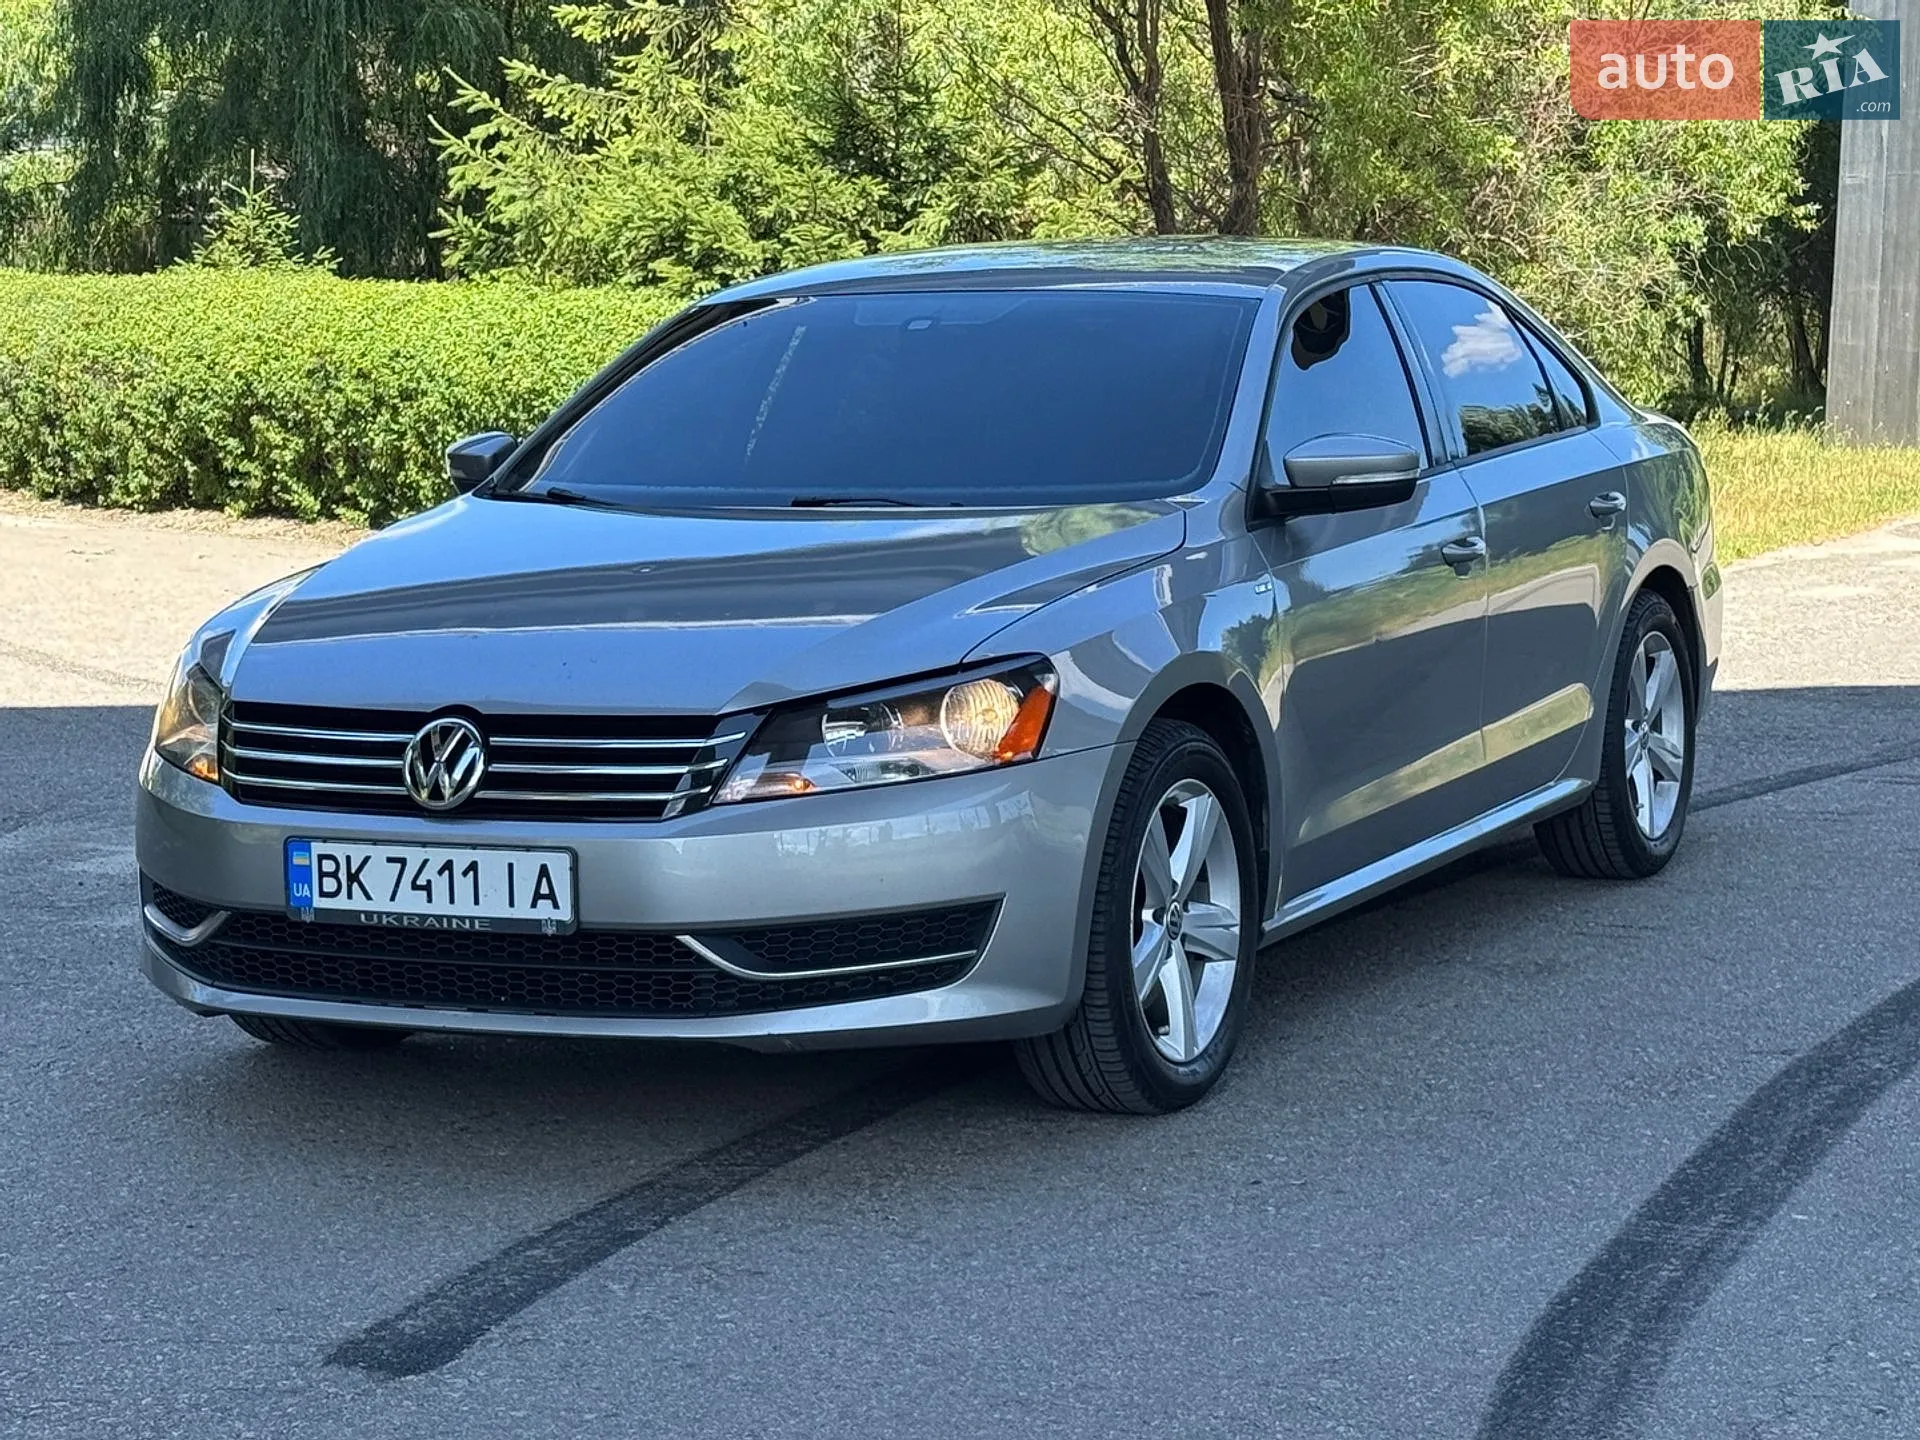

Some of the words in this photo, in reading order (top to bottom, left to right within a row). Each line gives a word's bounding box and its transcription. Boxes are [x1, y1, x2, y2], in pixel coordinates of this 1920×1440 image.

[317, 854, 373, 901] BK
[386, 857, 480, 906] 7411
[508, 862, 560, 909] IA
[293, 884, 311, 898] UA
[360, 913, 492, 930] UKRAINE
